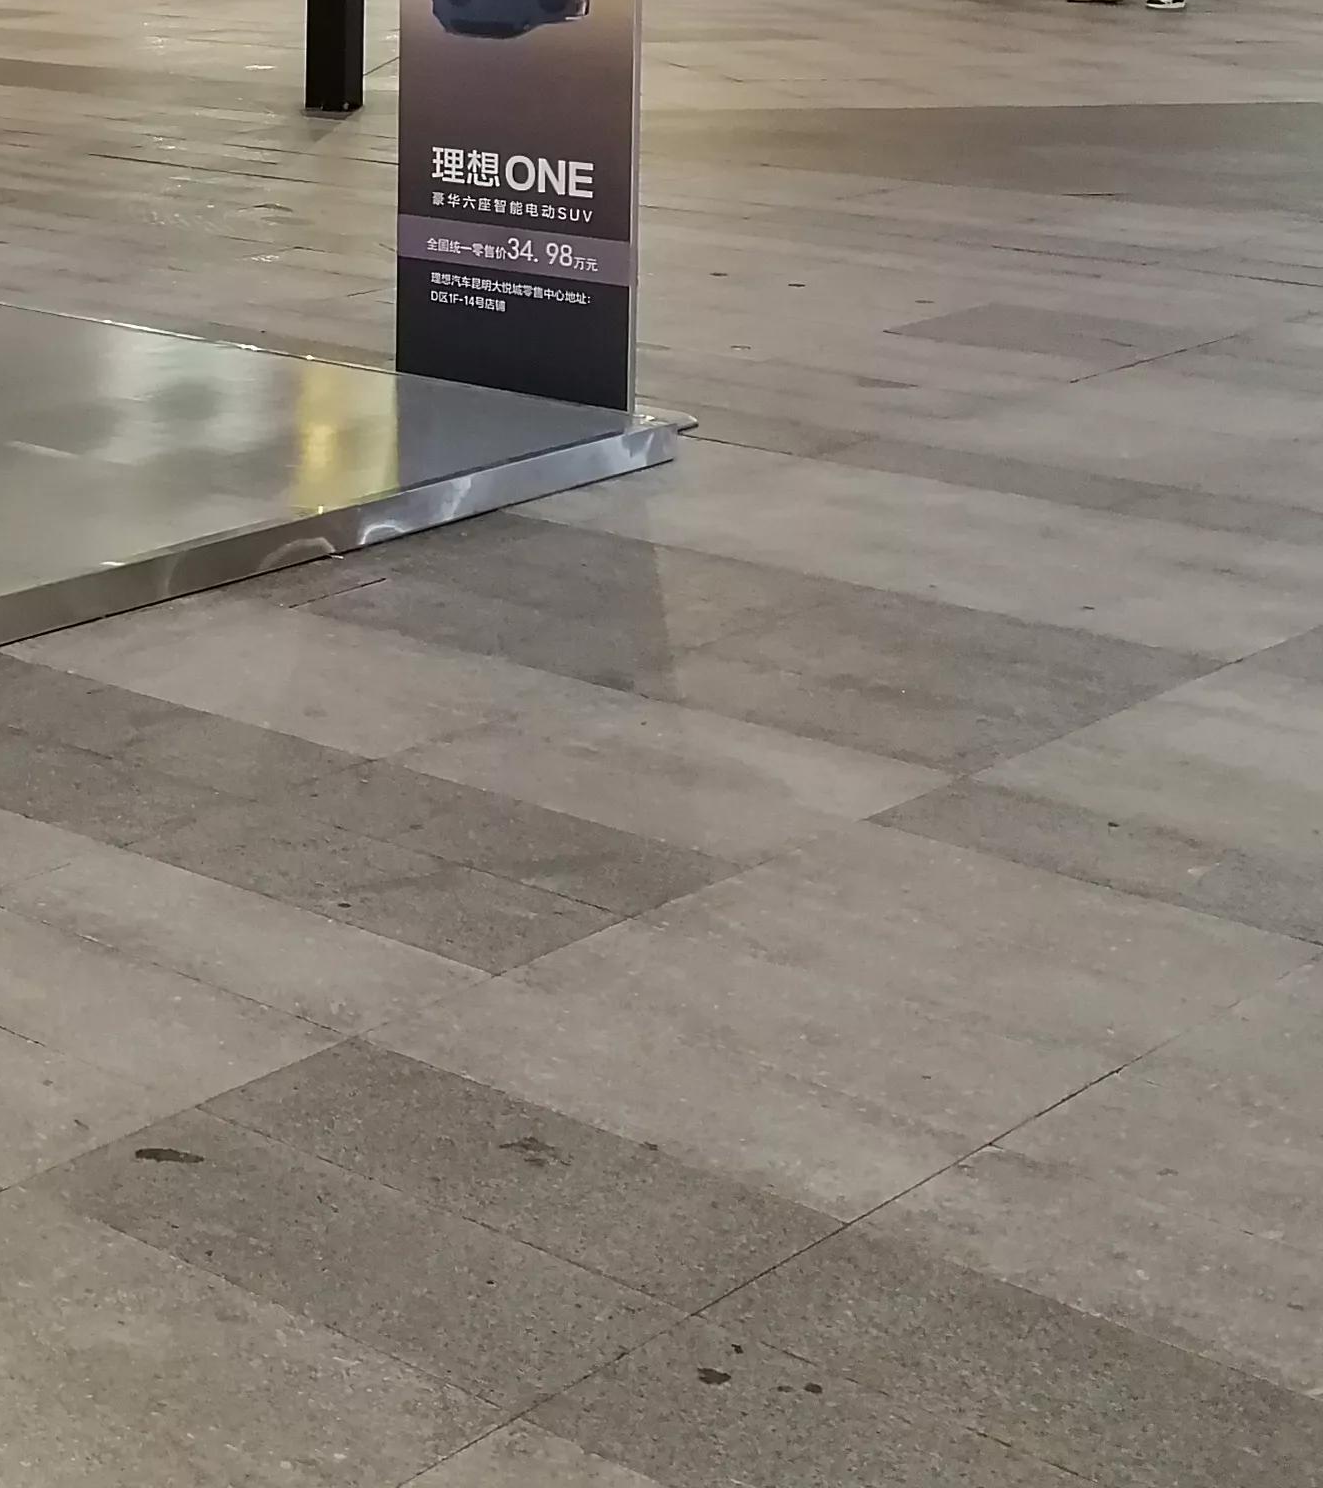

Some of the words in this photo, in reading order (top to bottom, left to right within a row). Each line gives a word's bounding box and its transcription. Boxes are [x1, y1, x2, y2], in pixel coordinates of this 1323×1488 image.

[431, 146, 594, 199] 理想ONE
[432, 190, 593, 223] 豪华六座智能电动SUV
